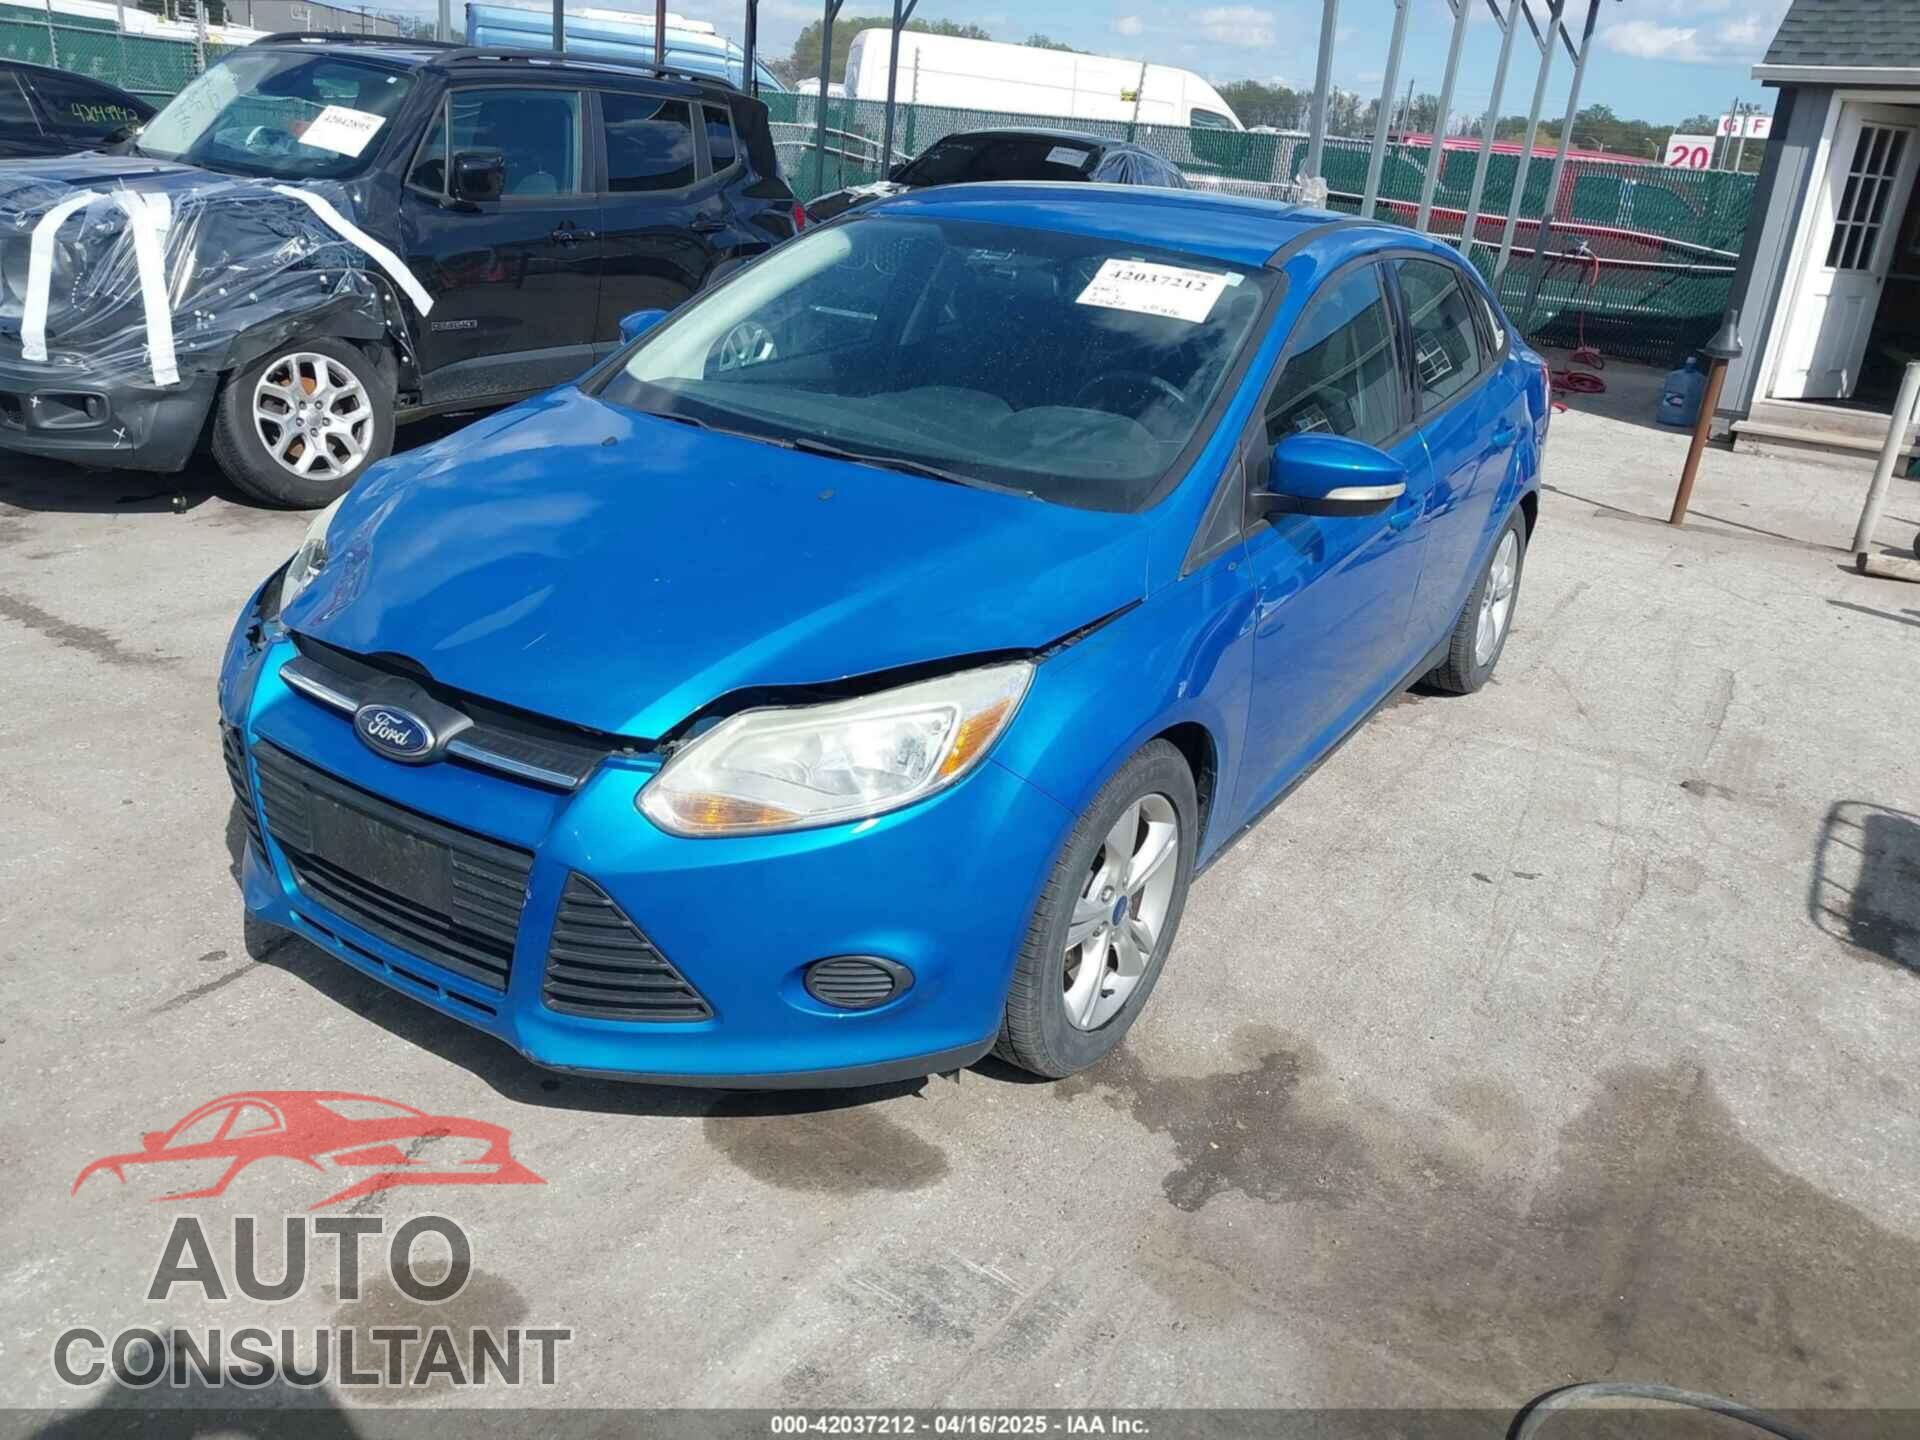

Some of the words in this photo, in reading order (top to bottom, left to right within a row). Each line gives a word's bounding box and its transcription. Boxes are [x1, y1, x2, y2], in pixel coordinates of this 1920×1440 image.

[1670, 145, 1709, 168] 20
[1109, 269, 1208, 292] 42037212
[368, 711, 412, 746] Ford
